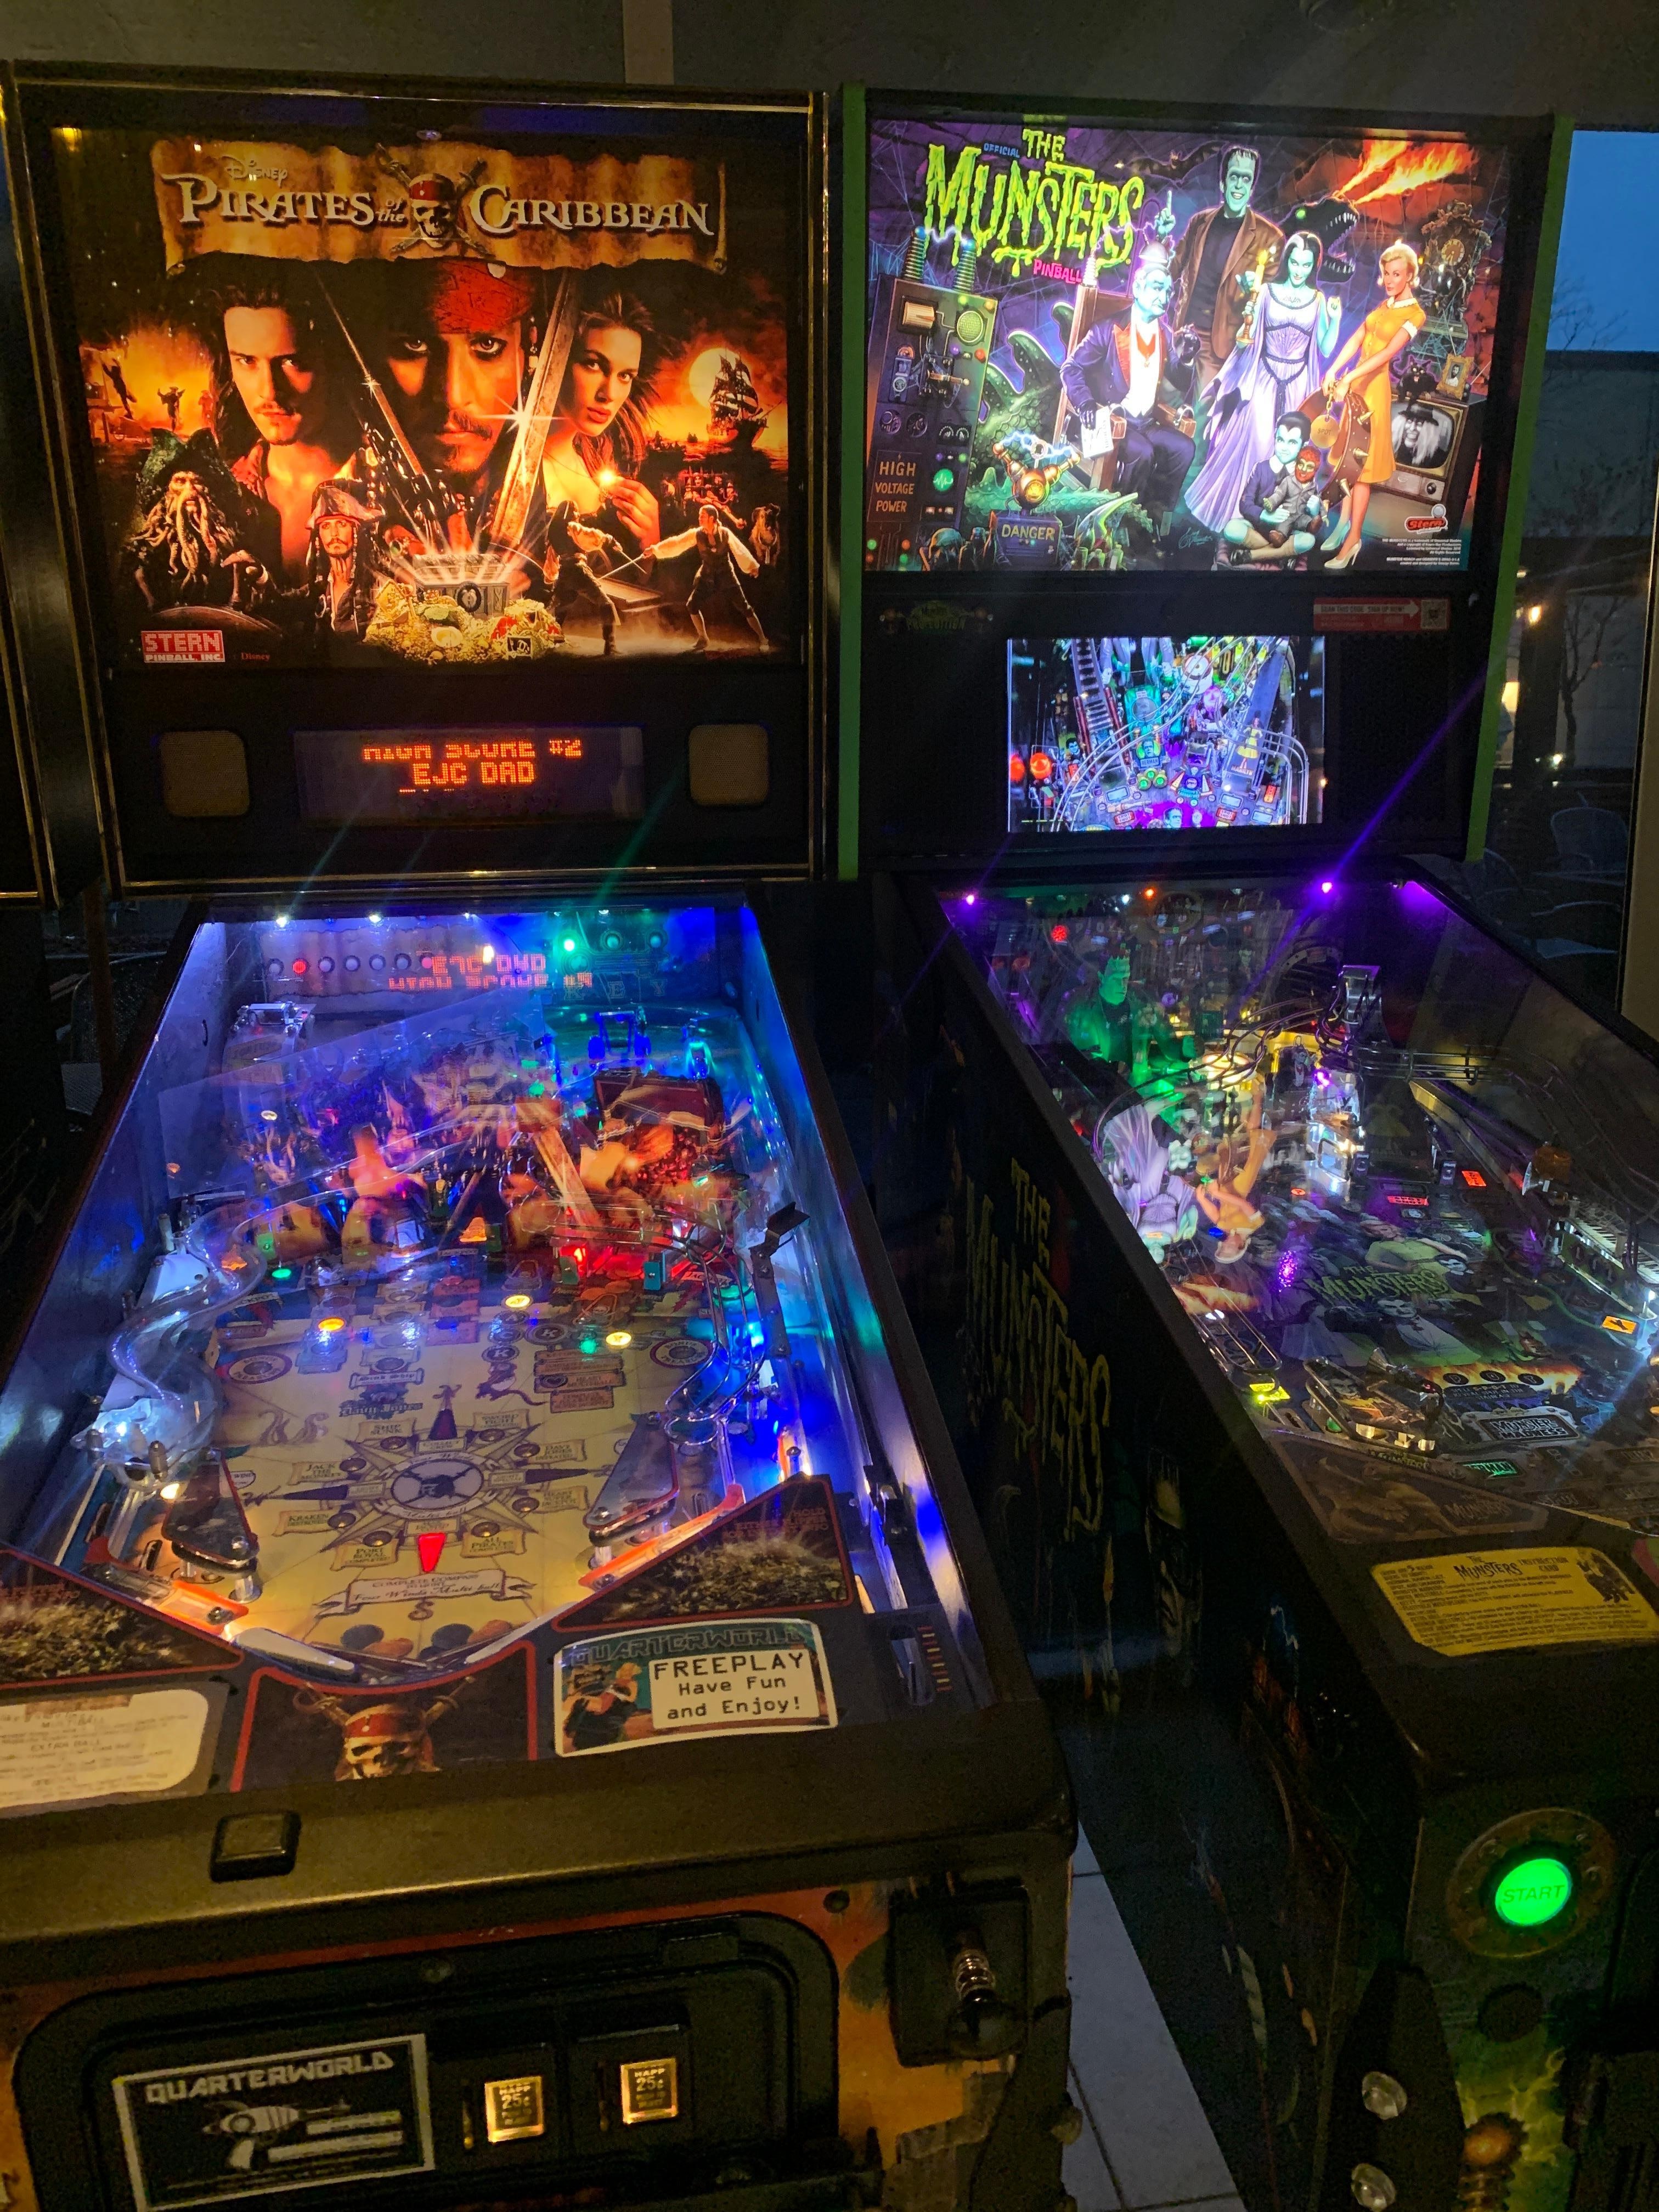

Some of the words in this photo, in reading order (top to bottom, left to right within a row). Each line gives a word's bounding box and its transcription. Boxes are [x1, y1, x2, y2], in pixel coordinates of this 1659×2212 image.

[984, 143, 1020, 158] OFFICIAL
[1023, 129, 1065, 162] THE
[162, 173, 374, 226] PIRATES
[385, 198, 404, 211] of
[470, 183, 714, 235] CARIBBEAN
[378, 209, 405, 222] the
[924, 144, 1144, 276] MUNSTERS
[1034, 259, 1084, 284] PINBALL
[879, 461, 916, 476] HIGH
[874, 482, 915, 494] VOLTAGE
[876, 500, 907, 512] POWER
[1001, 524, 1055, 540] DANGER
[145, 633, 220, 652] STERN
[413, 762, 466, 785] EJC
[481, 761, 535, 783] DAD
[1344, 1266, 1378, 1274] THE
[1304, 1268, 1448, 1305] MUNSTERS
[1492, 1418, 1558, 1432] MUNSTER
[1500, 1427, 1569, 1440] MADNESS
[1453, 1561, 1522, 1581] MUNSTERS
[653, 1652, 803, 1680] FREEPLAY
[679, 1678, 731, 1696] Have
[747, 1675, 786, 1690] Fun
[667, 1702, 707, 1720] and
[723, 1697, 800, 1716] Enjoy!
[1503, 1883, 1565, 1904] START
[145, 2051, 394, 2104] QUARTERWORLD
